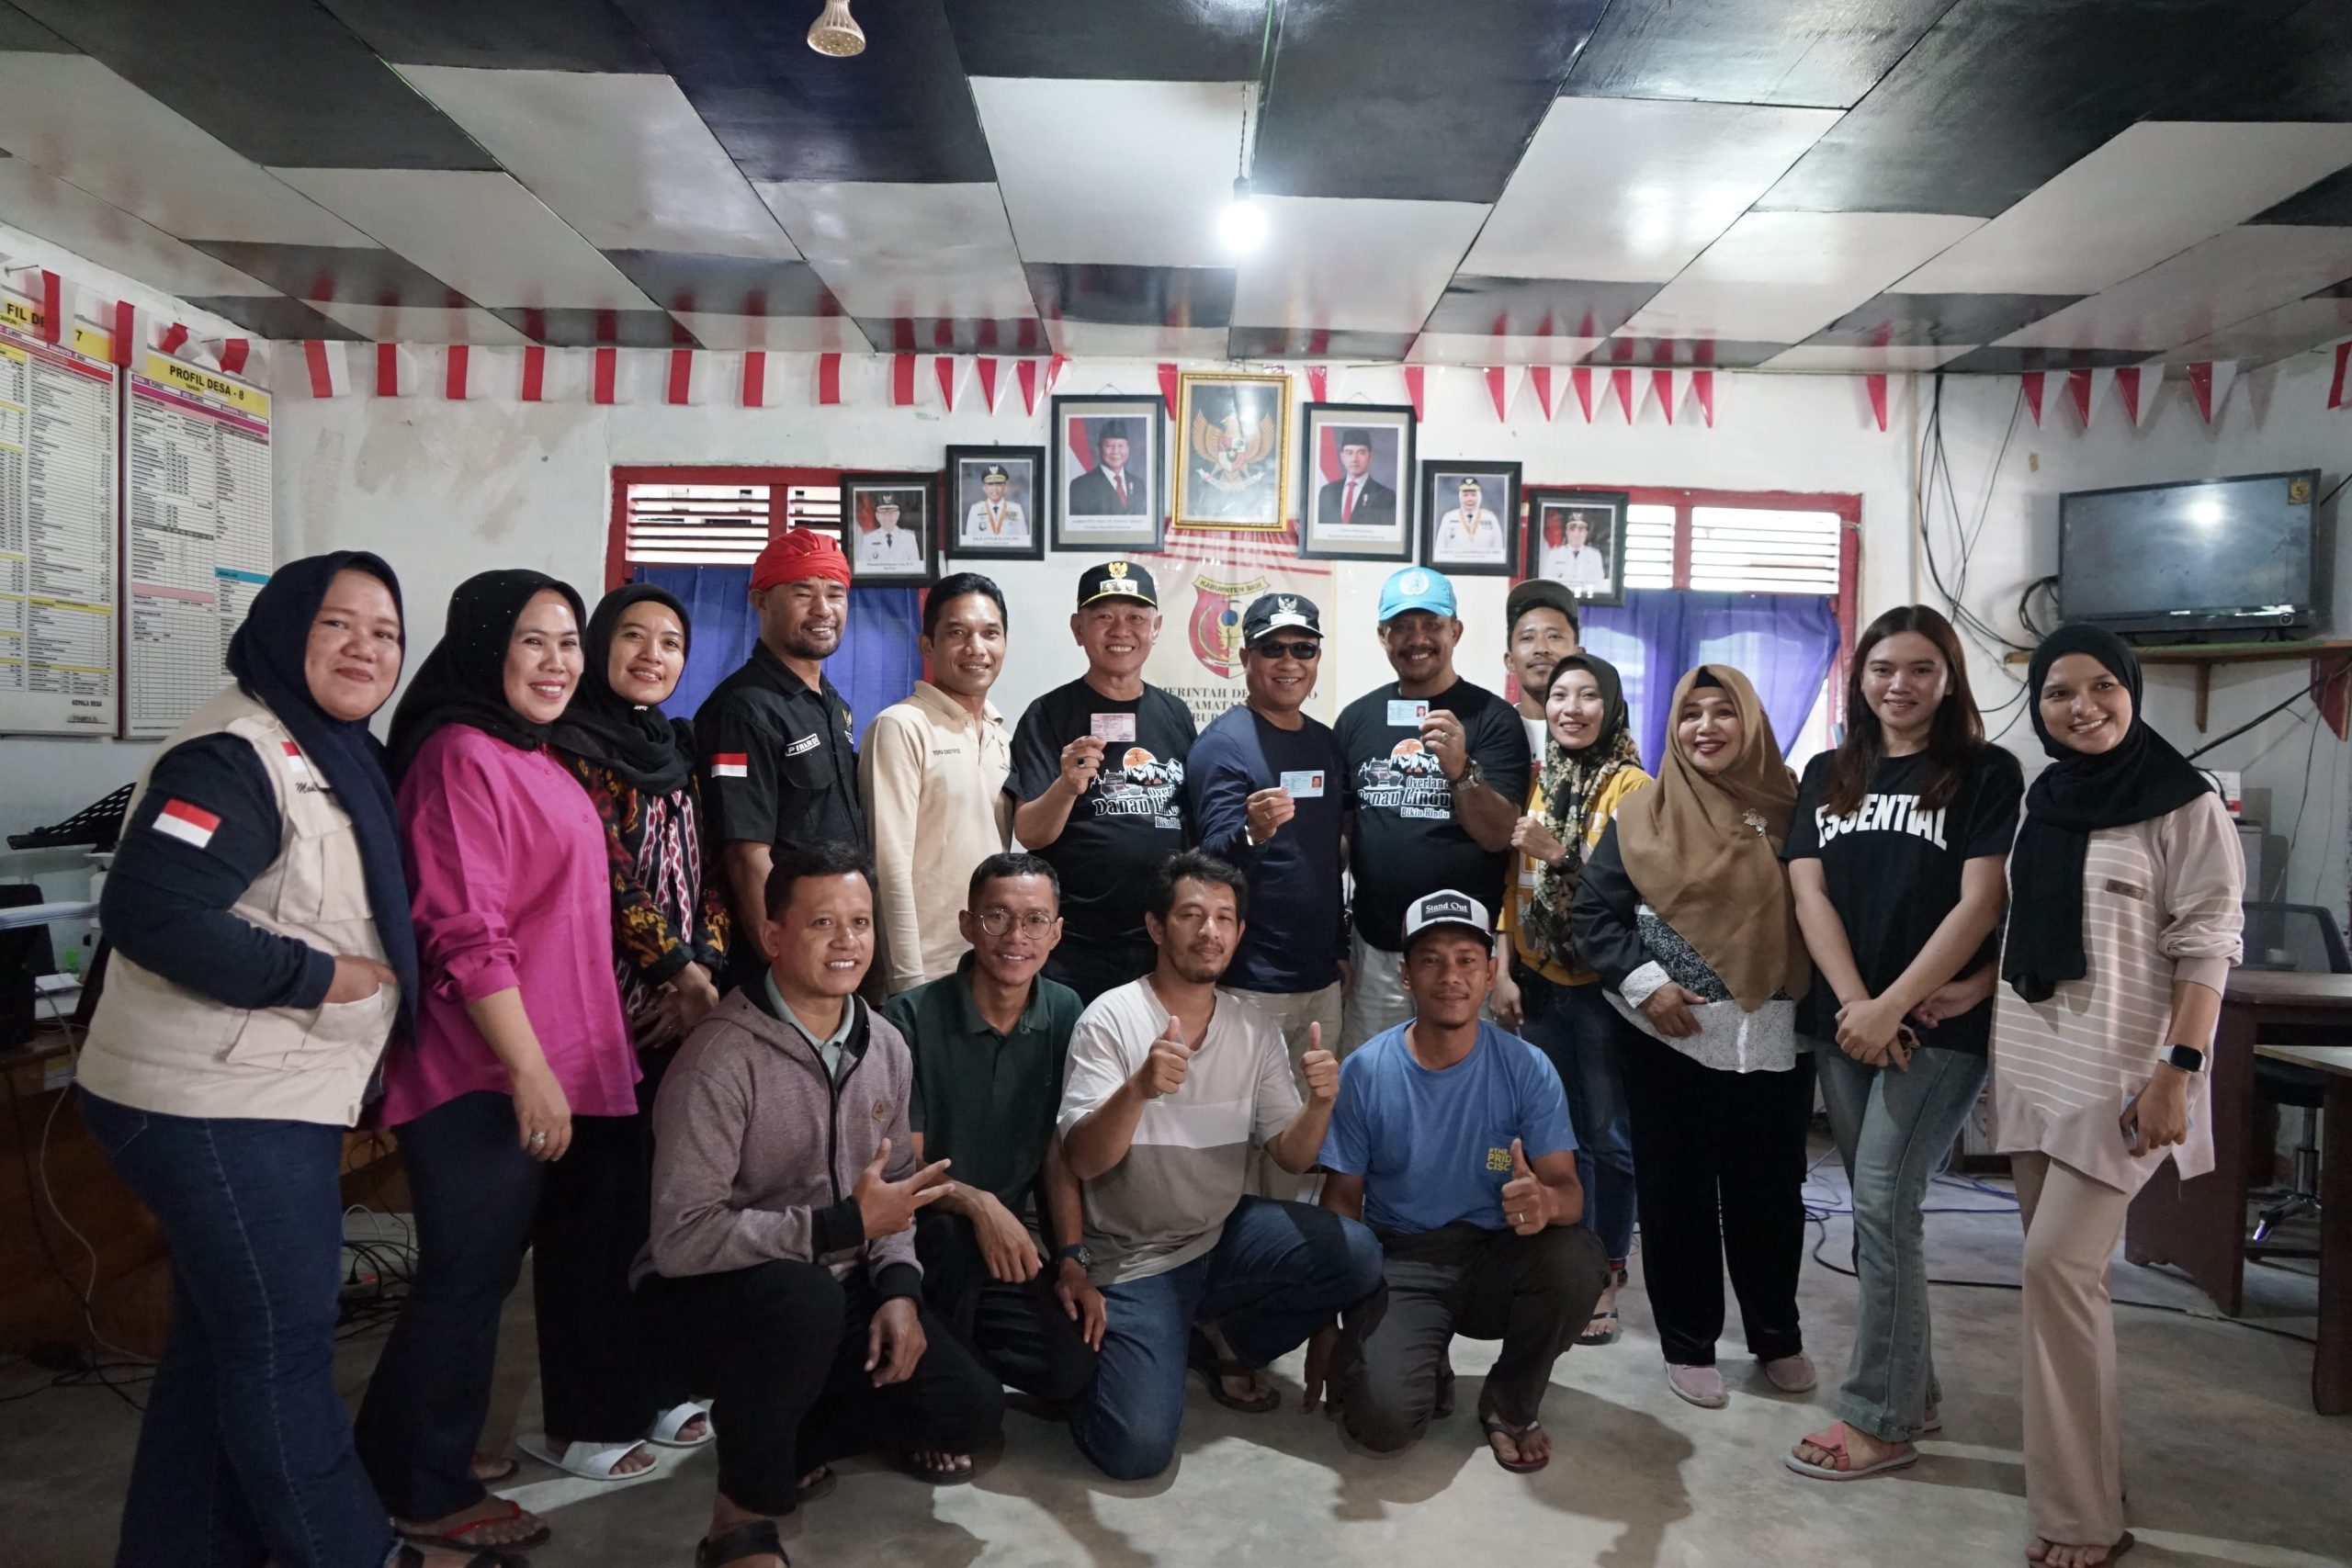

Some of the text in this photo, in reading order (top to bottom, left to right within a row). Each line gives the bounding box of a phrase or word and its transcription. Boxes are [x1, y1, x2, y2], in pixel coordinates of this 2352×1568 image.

[7, 303, 28, 321] FIL
[75, 330, 83, 342] 7
[169, 365, 205, 387] PROFIL
[206, 378, 232, 396] DESA
[238, 389, 244, 400] 8
[1200, 580, 1244, 593] KABUPATEN
[1161, 687, 1248, 698] ERINTAH DE
[1401, 788, 1451, 807] Lindu
[1092, 797, 1152, 817] Danau
[1426, 901, 1468, 912] Stand Out
[1487, 1153, 1512, 1163] PRID
[1486, 1161, 1511, 1171] CISC
